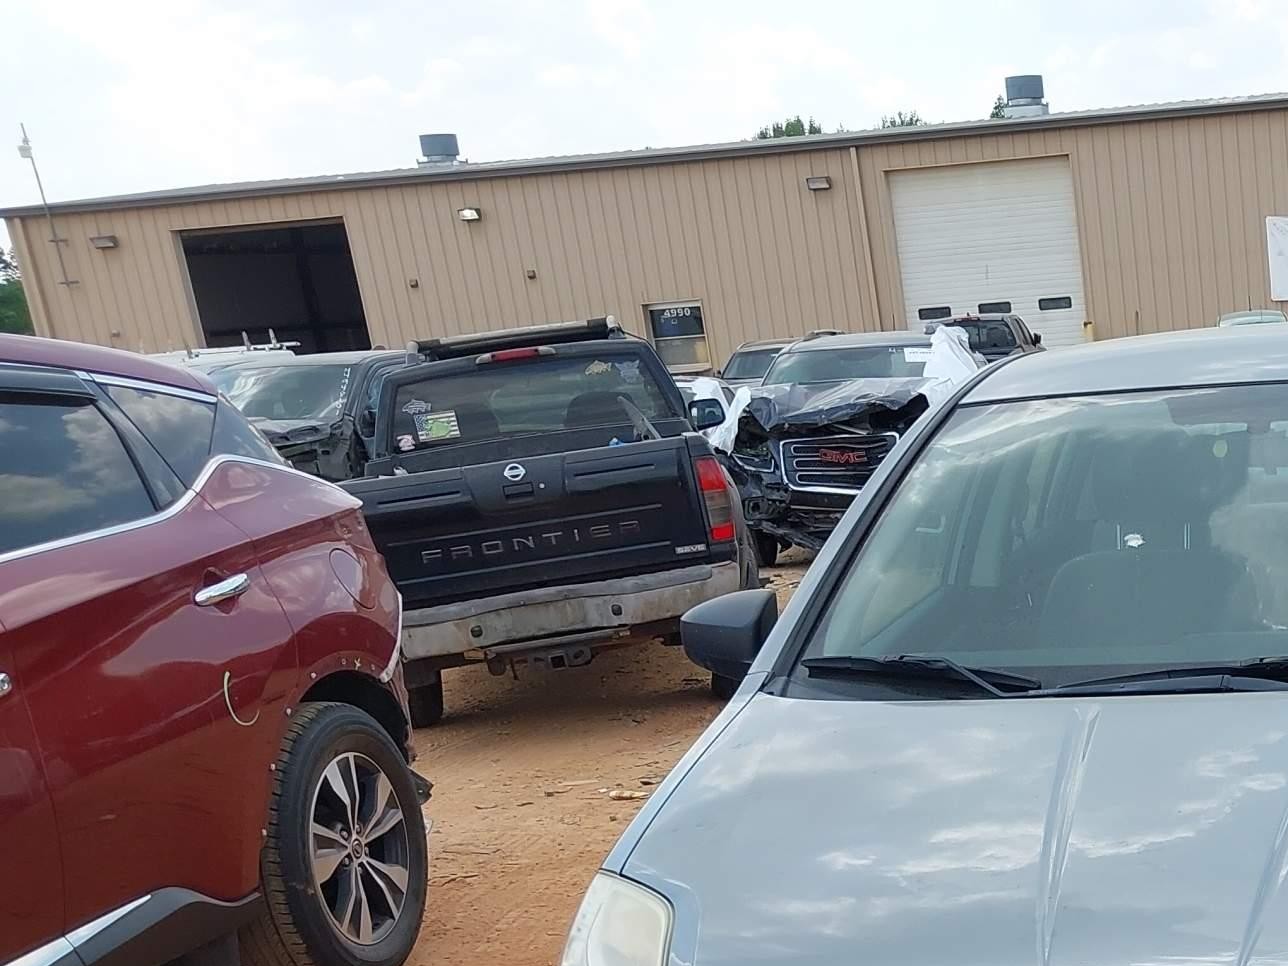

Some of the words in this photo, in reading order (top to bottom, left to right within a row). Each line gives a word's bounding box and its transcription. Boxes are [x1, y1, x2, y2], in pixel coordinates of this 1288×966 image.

[664, 308, 691, 318] 4990
[819, 448, 868, 464] GMC
[421, 520, 640, 564] FRONTIER
